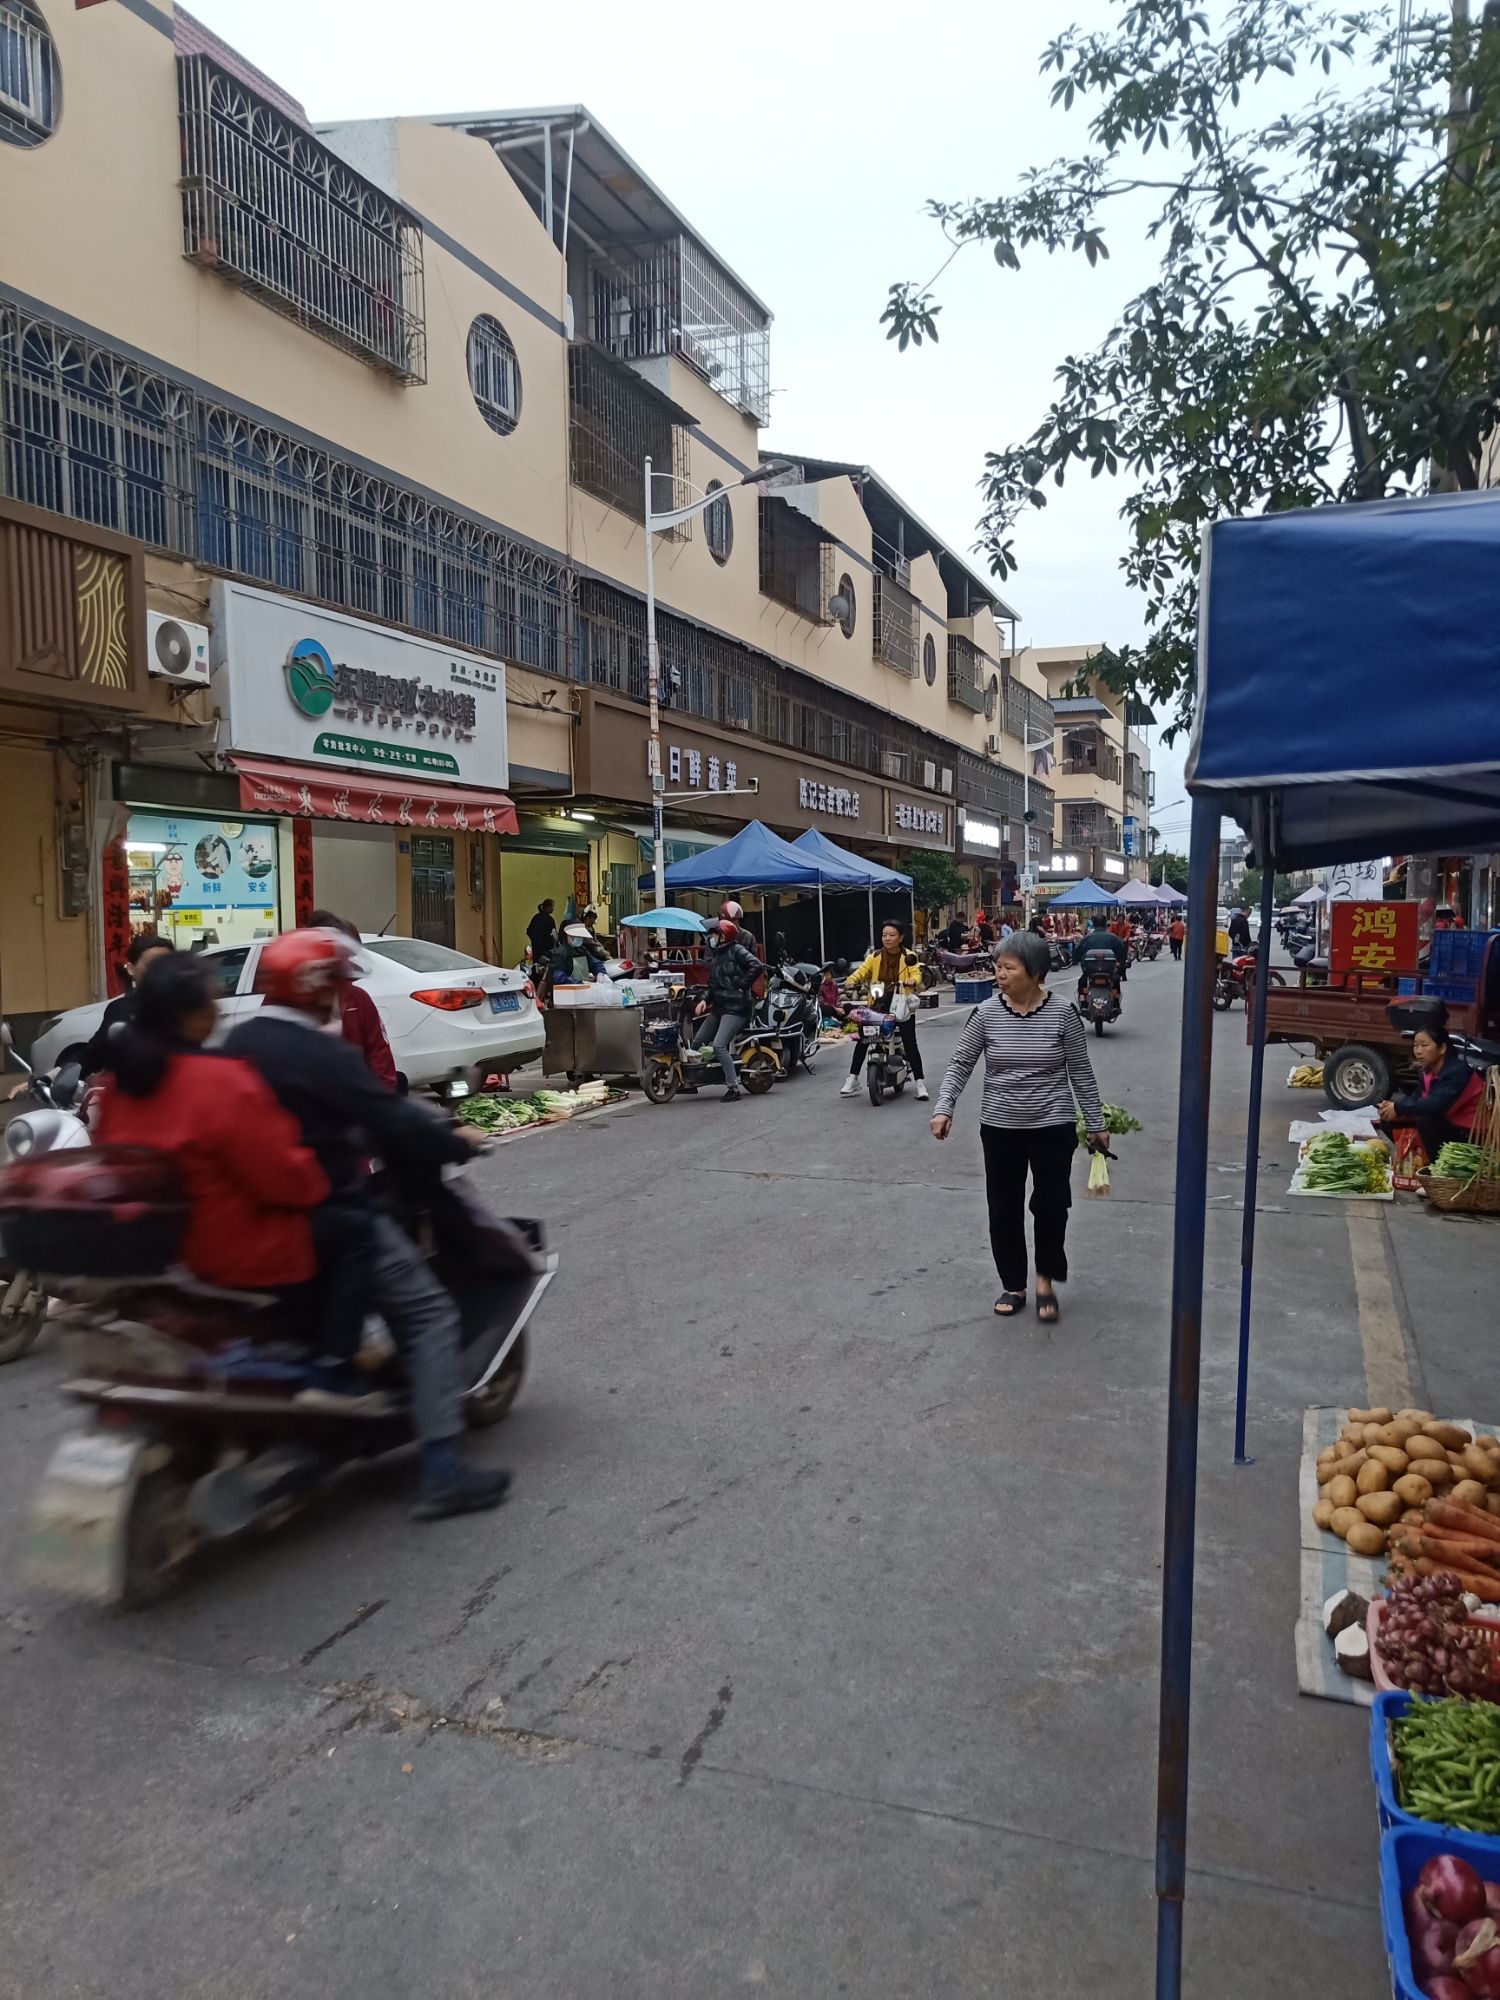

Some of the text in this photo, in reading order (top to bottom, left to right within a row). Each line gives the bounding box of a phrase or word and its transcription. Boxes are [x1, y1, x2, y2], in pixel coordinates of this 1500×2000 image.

[202, 880, 268, 894] 新鲜 安全
[1351, 906, 1397, 988] 鸿安
